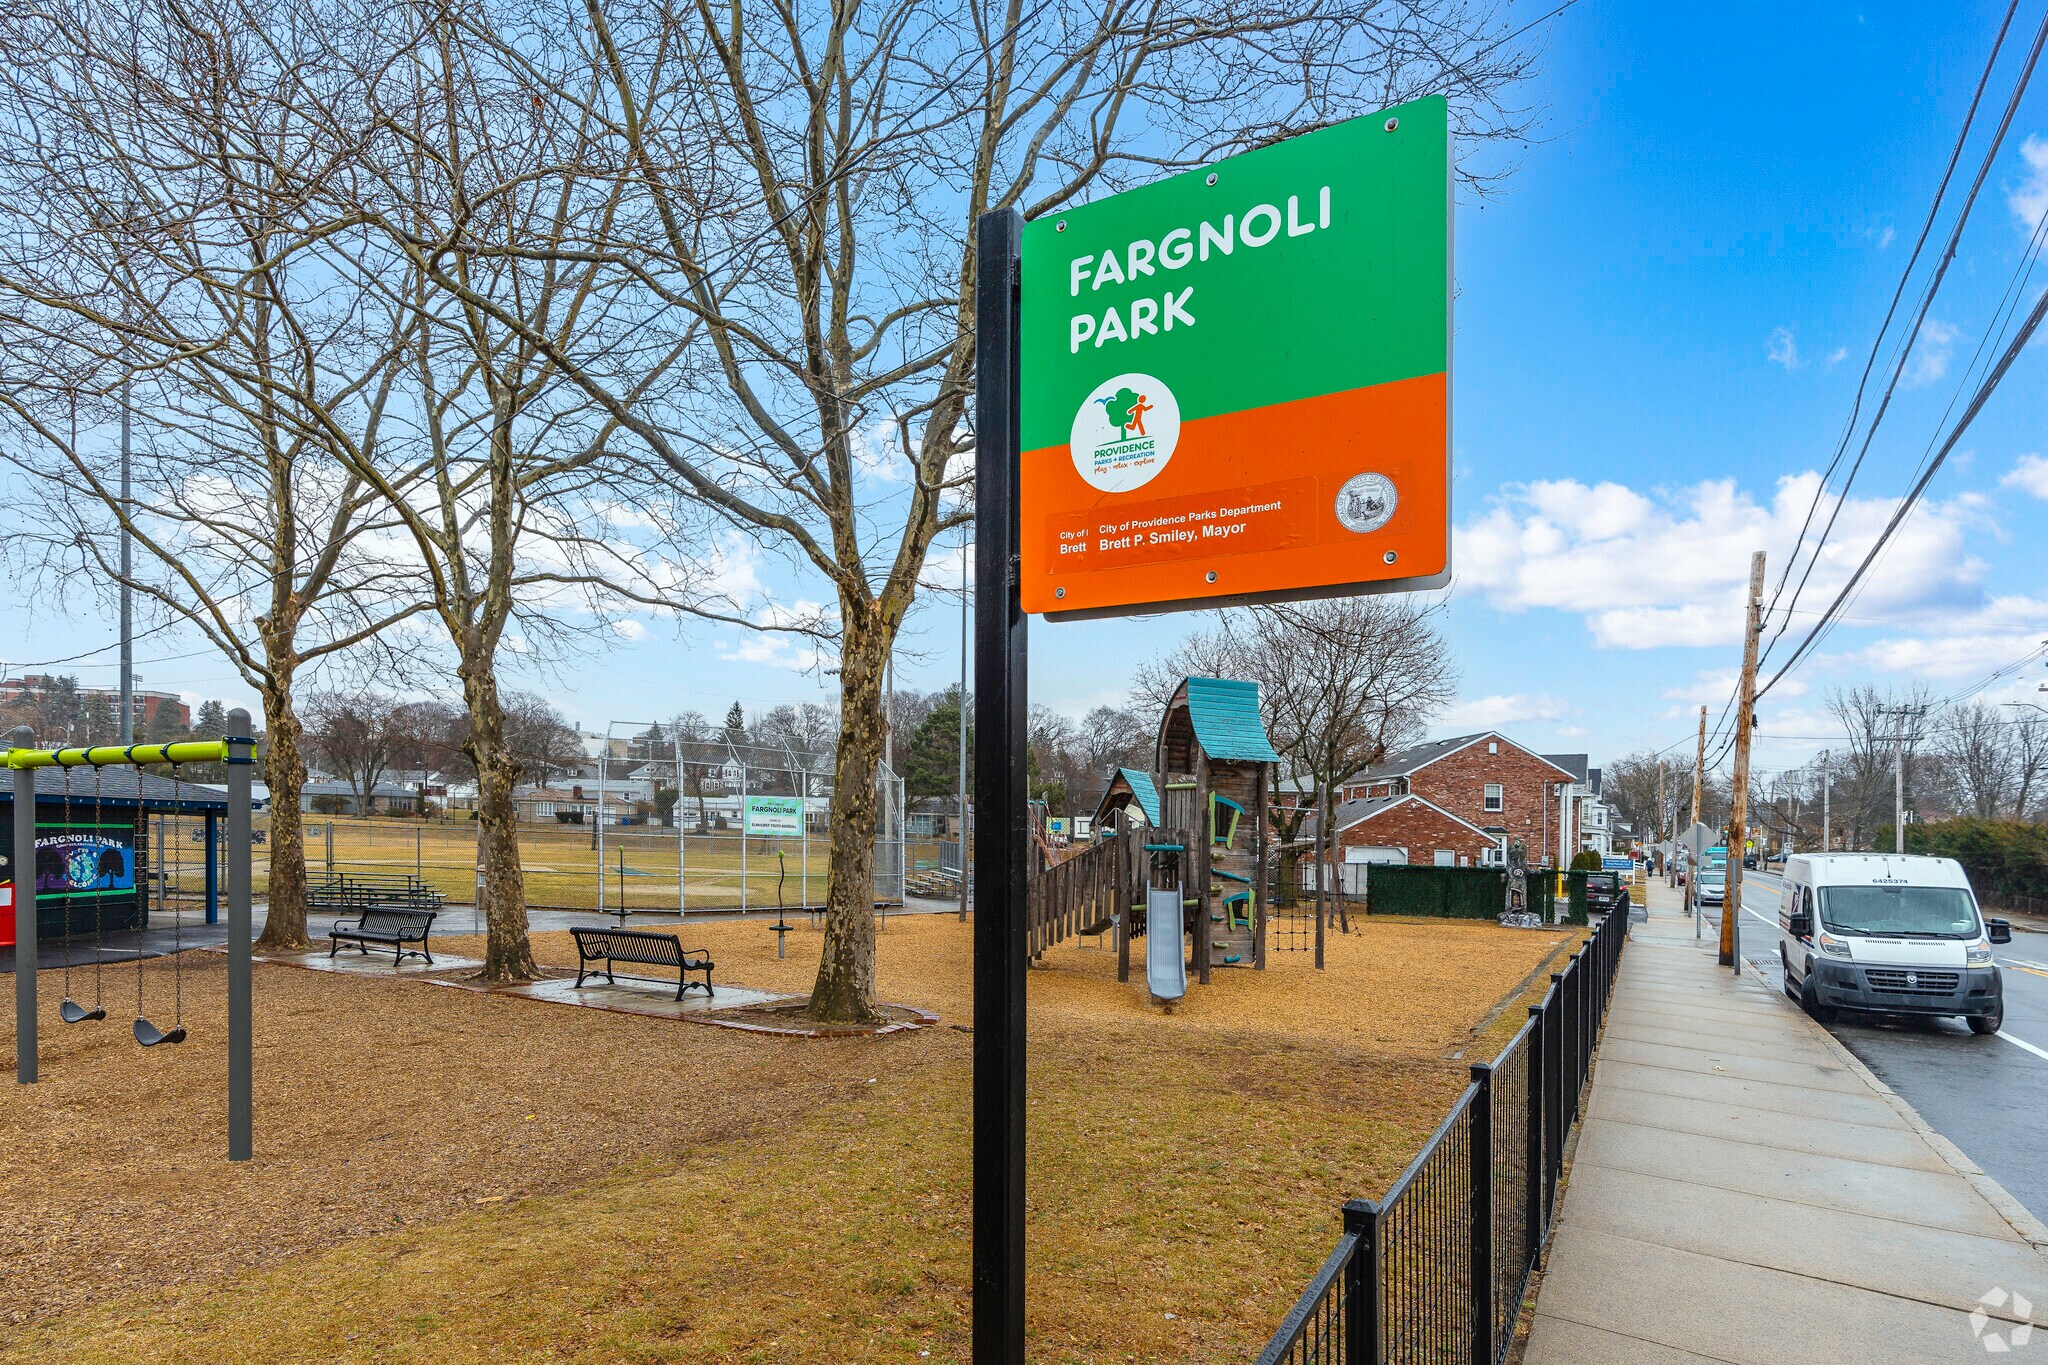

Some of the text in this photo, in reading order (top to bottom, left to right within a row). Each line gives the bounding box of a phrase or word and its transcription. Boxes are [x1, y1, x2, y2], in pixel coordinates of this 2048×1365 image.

[1071, 186, 1330, 297] FARGNOLI
[1071, 286, 1195, 354] PARK
[1094, 440, 1155, 459] PROVIDENCE
[1094, 458, 1112, 466] PARKS
[1118, 450, 1155, 461] RECREATION
[1133, 457, 1155, 467] explore
[1099, 524, 1117, 534] City
[1119, 521, 1130, 531] of
[1131, 515, 1186, 530] Providence
[1188, 510, 1217, 522] Parks
[1219, 500, 1282, 518] Department
[1060, 531, 1075, 540] City
[1076, 529, 1085, 538] of
[1099, 523, 1247, 551] Brett P. Smiley, Mayor
[1060, 541, 1087, 555] Brett
[35, 834, 94, 849] FARGNOLI
[95, 835, 123, 850] PARK
